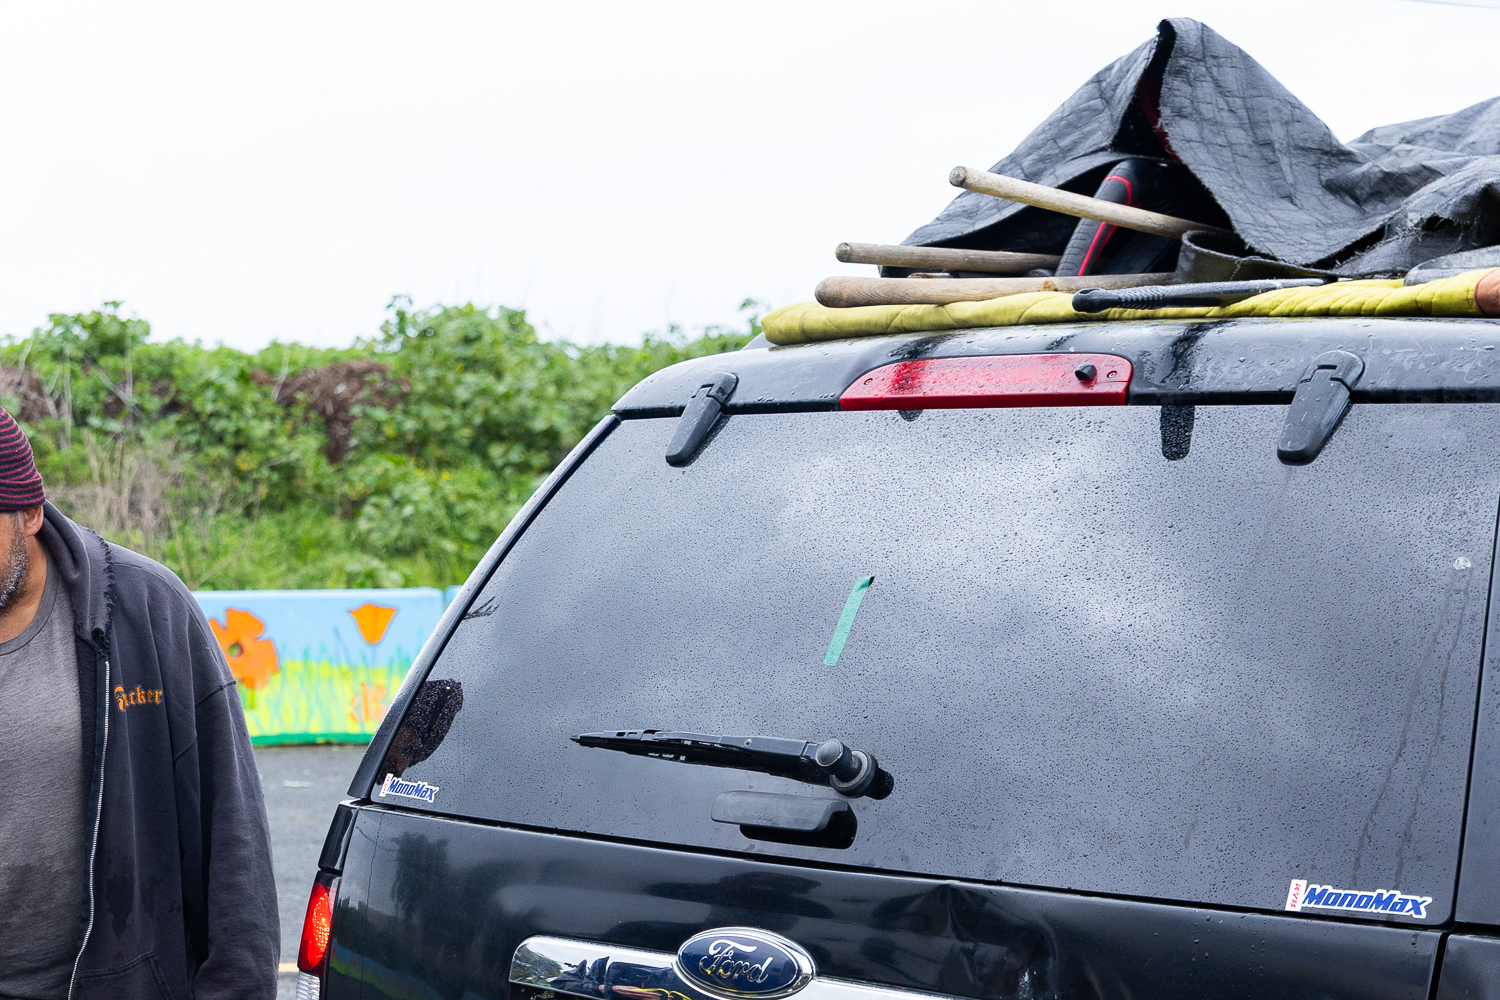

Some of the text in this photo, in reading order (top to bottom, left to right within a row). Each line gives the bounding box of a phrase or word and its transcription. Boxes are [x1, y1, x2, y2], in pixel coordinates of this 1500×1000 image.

[387, 779, 437, 801] MonoMax
[1302, 887, 1428, 916] MonoMax
[699, 938, 774, 984] Ford
